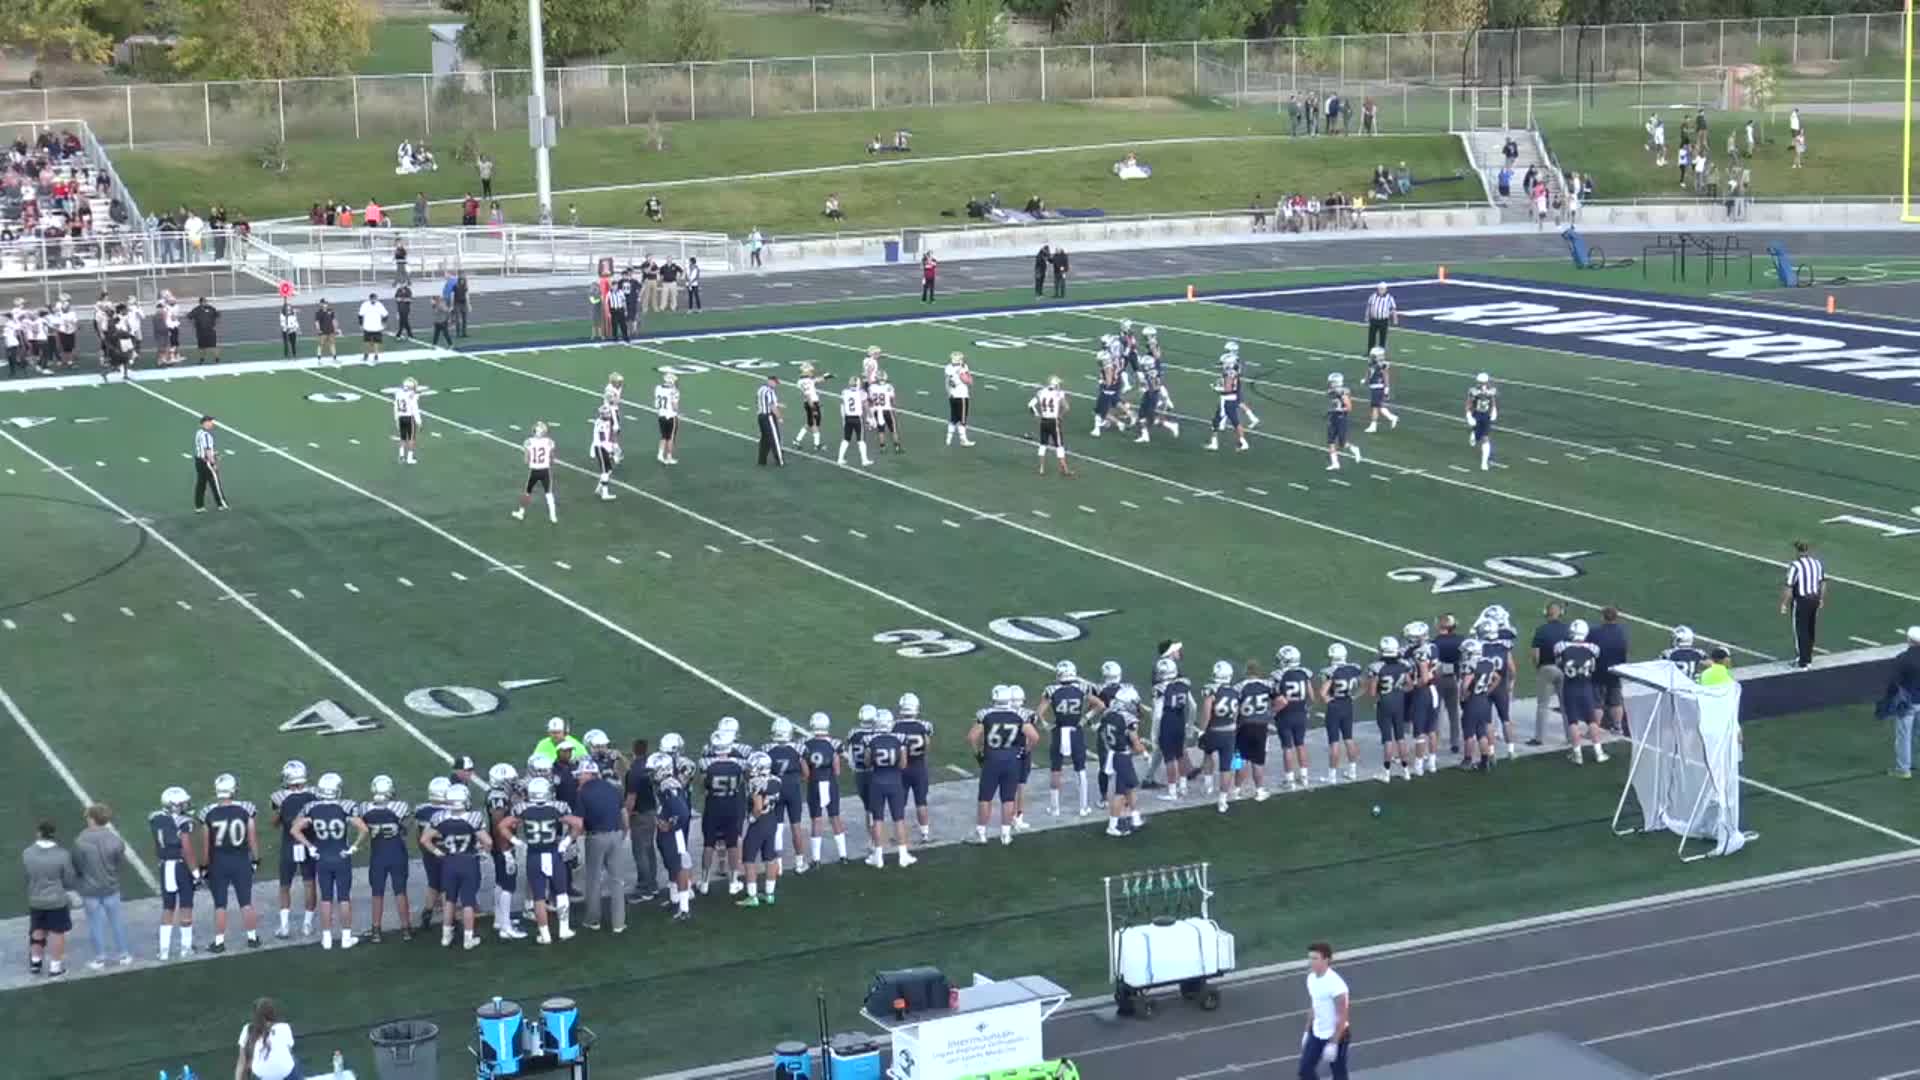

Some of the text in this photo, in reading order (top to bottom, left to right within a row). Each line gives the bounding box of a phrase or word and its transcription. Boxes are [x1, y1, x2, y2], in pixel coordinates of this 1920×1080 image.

[1398, 301, 1920, 386] RIVERH
[848, 397, 856, 412] 2
[1041, 397, 1055, 412] 44
[532, 446, 546, 464] 12
[1386, 556, 1580, 594] 20
[872, 616, 1082, 658] 30
[1285, 680, 1306, 702] 21
[1056, 698, 1082, 715] 42
[1240, 693, 1270, 717] 65
[278, 698, 500, 737] 40
[986, 722, 1020, 749] 67
[810, 751, 824, 769] 9
[875, 748, 897, 767] 21
[711, 775, 738, 797] 51
[210, 817, 247, 847] 70
[524, 819, 557, 844] 35
